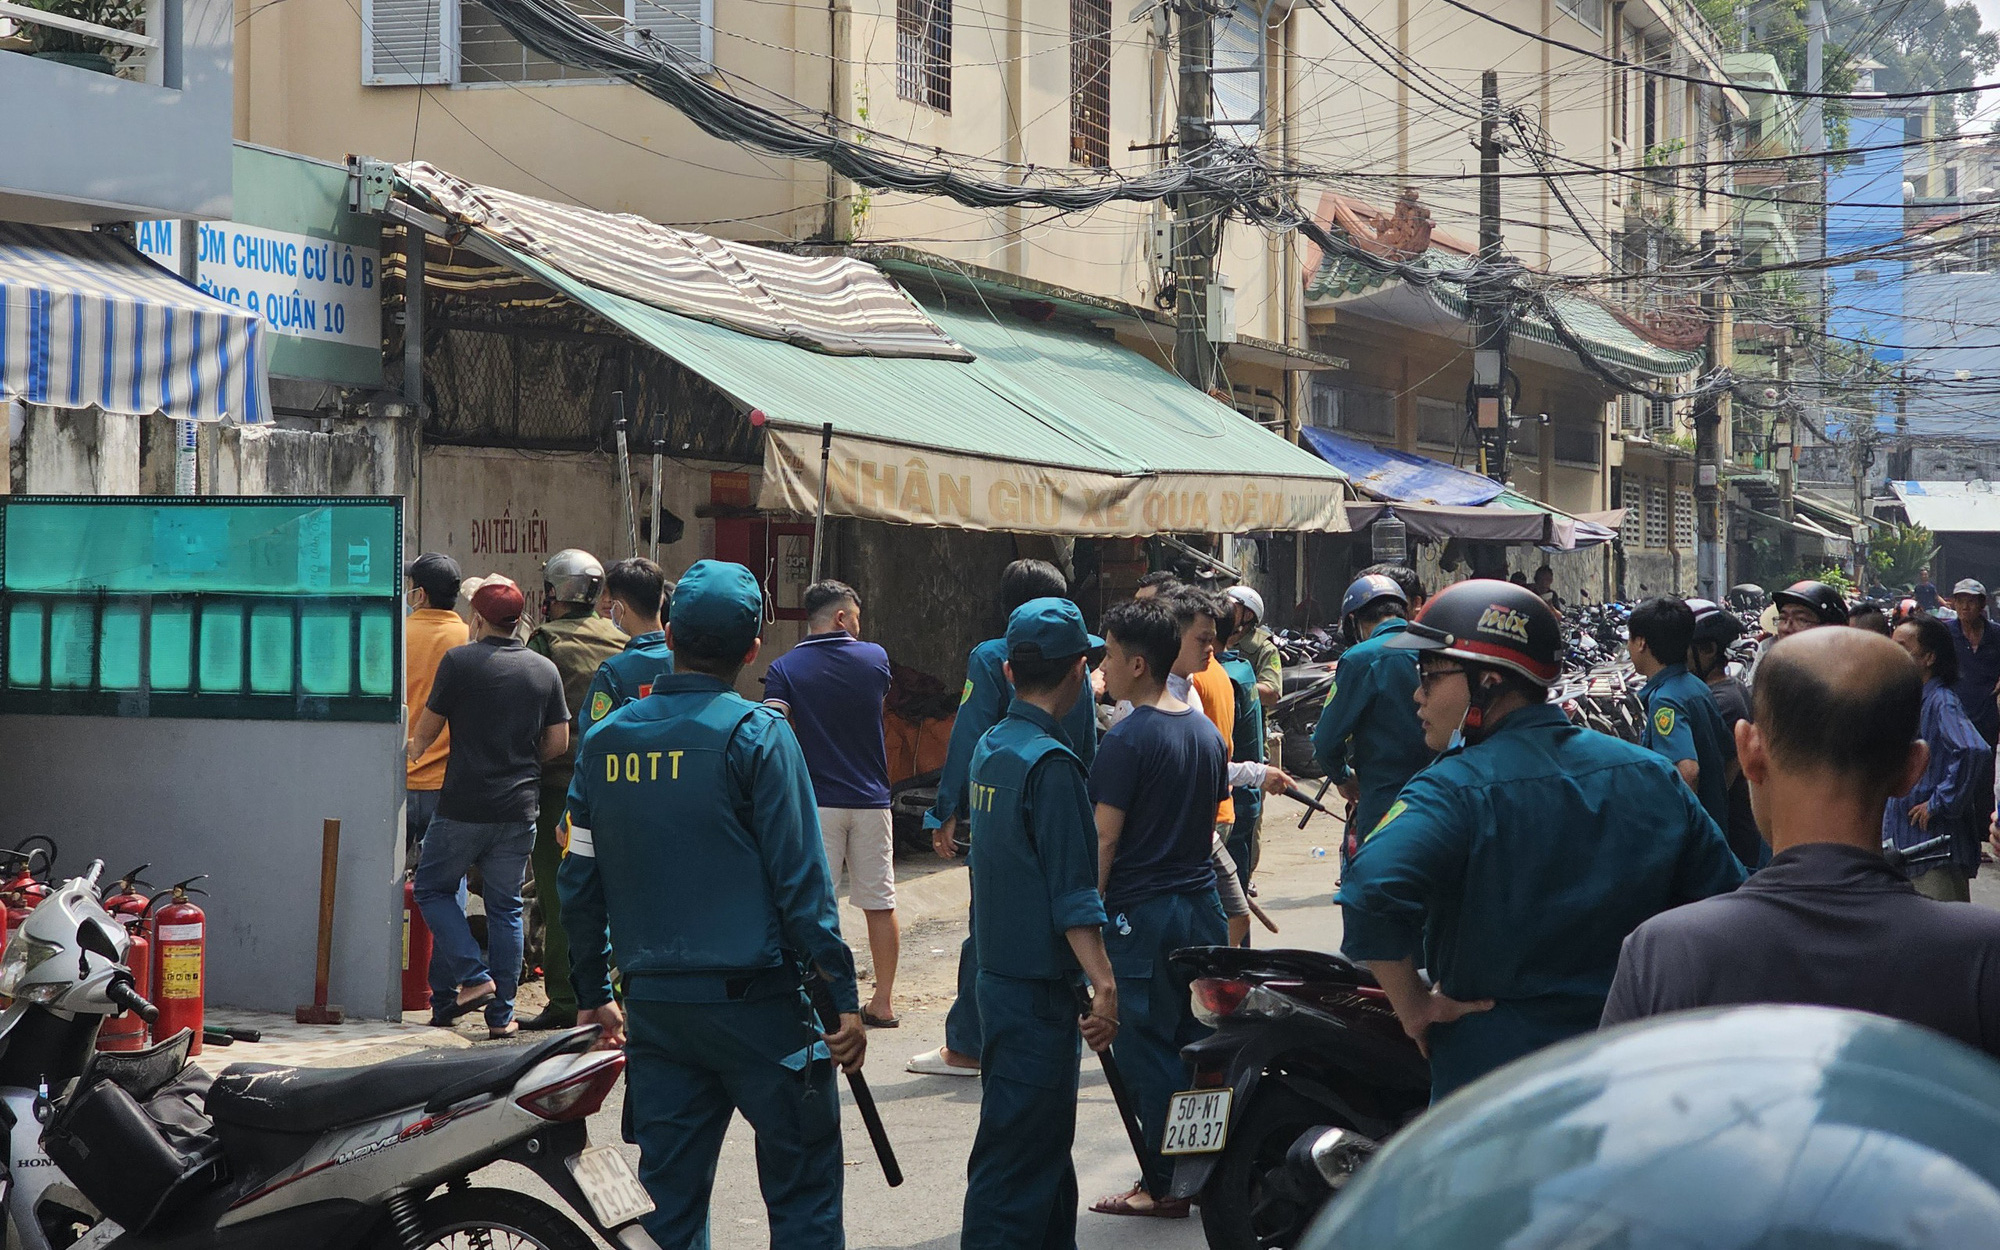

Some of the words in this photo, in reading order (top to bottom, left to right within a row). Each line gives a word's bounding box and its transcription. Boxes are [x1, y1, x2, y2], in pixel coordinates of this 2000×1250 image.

[199, 223, 226, 265] ƠM
[233, 233, 297, 278] CHUNG
[303, 243, 329, 282] CƯ
[333, 247, 355, 287] LÔ
[361, 257, 374, 289] B
[266, 289, 316, 335] QUẬN
[323, 302, 345, 334] 10
[1142, 491, 1210, 528] QUA
[1221, 481, 1284, 526] ĐÊM
[606, 750, 684, 784] DQTT
[1177, 1095, 1221, 1121] 50-N1
[1166, 1121, 1224, 1149] 248.37
[18, 1158, 59, 1168] HON
